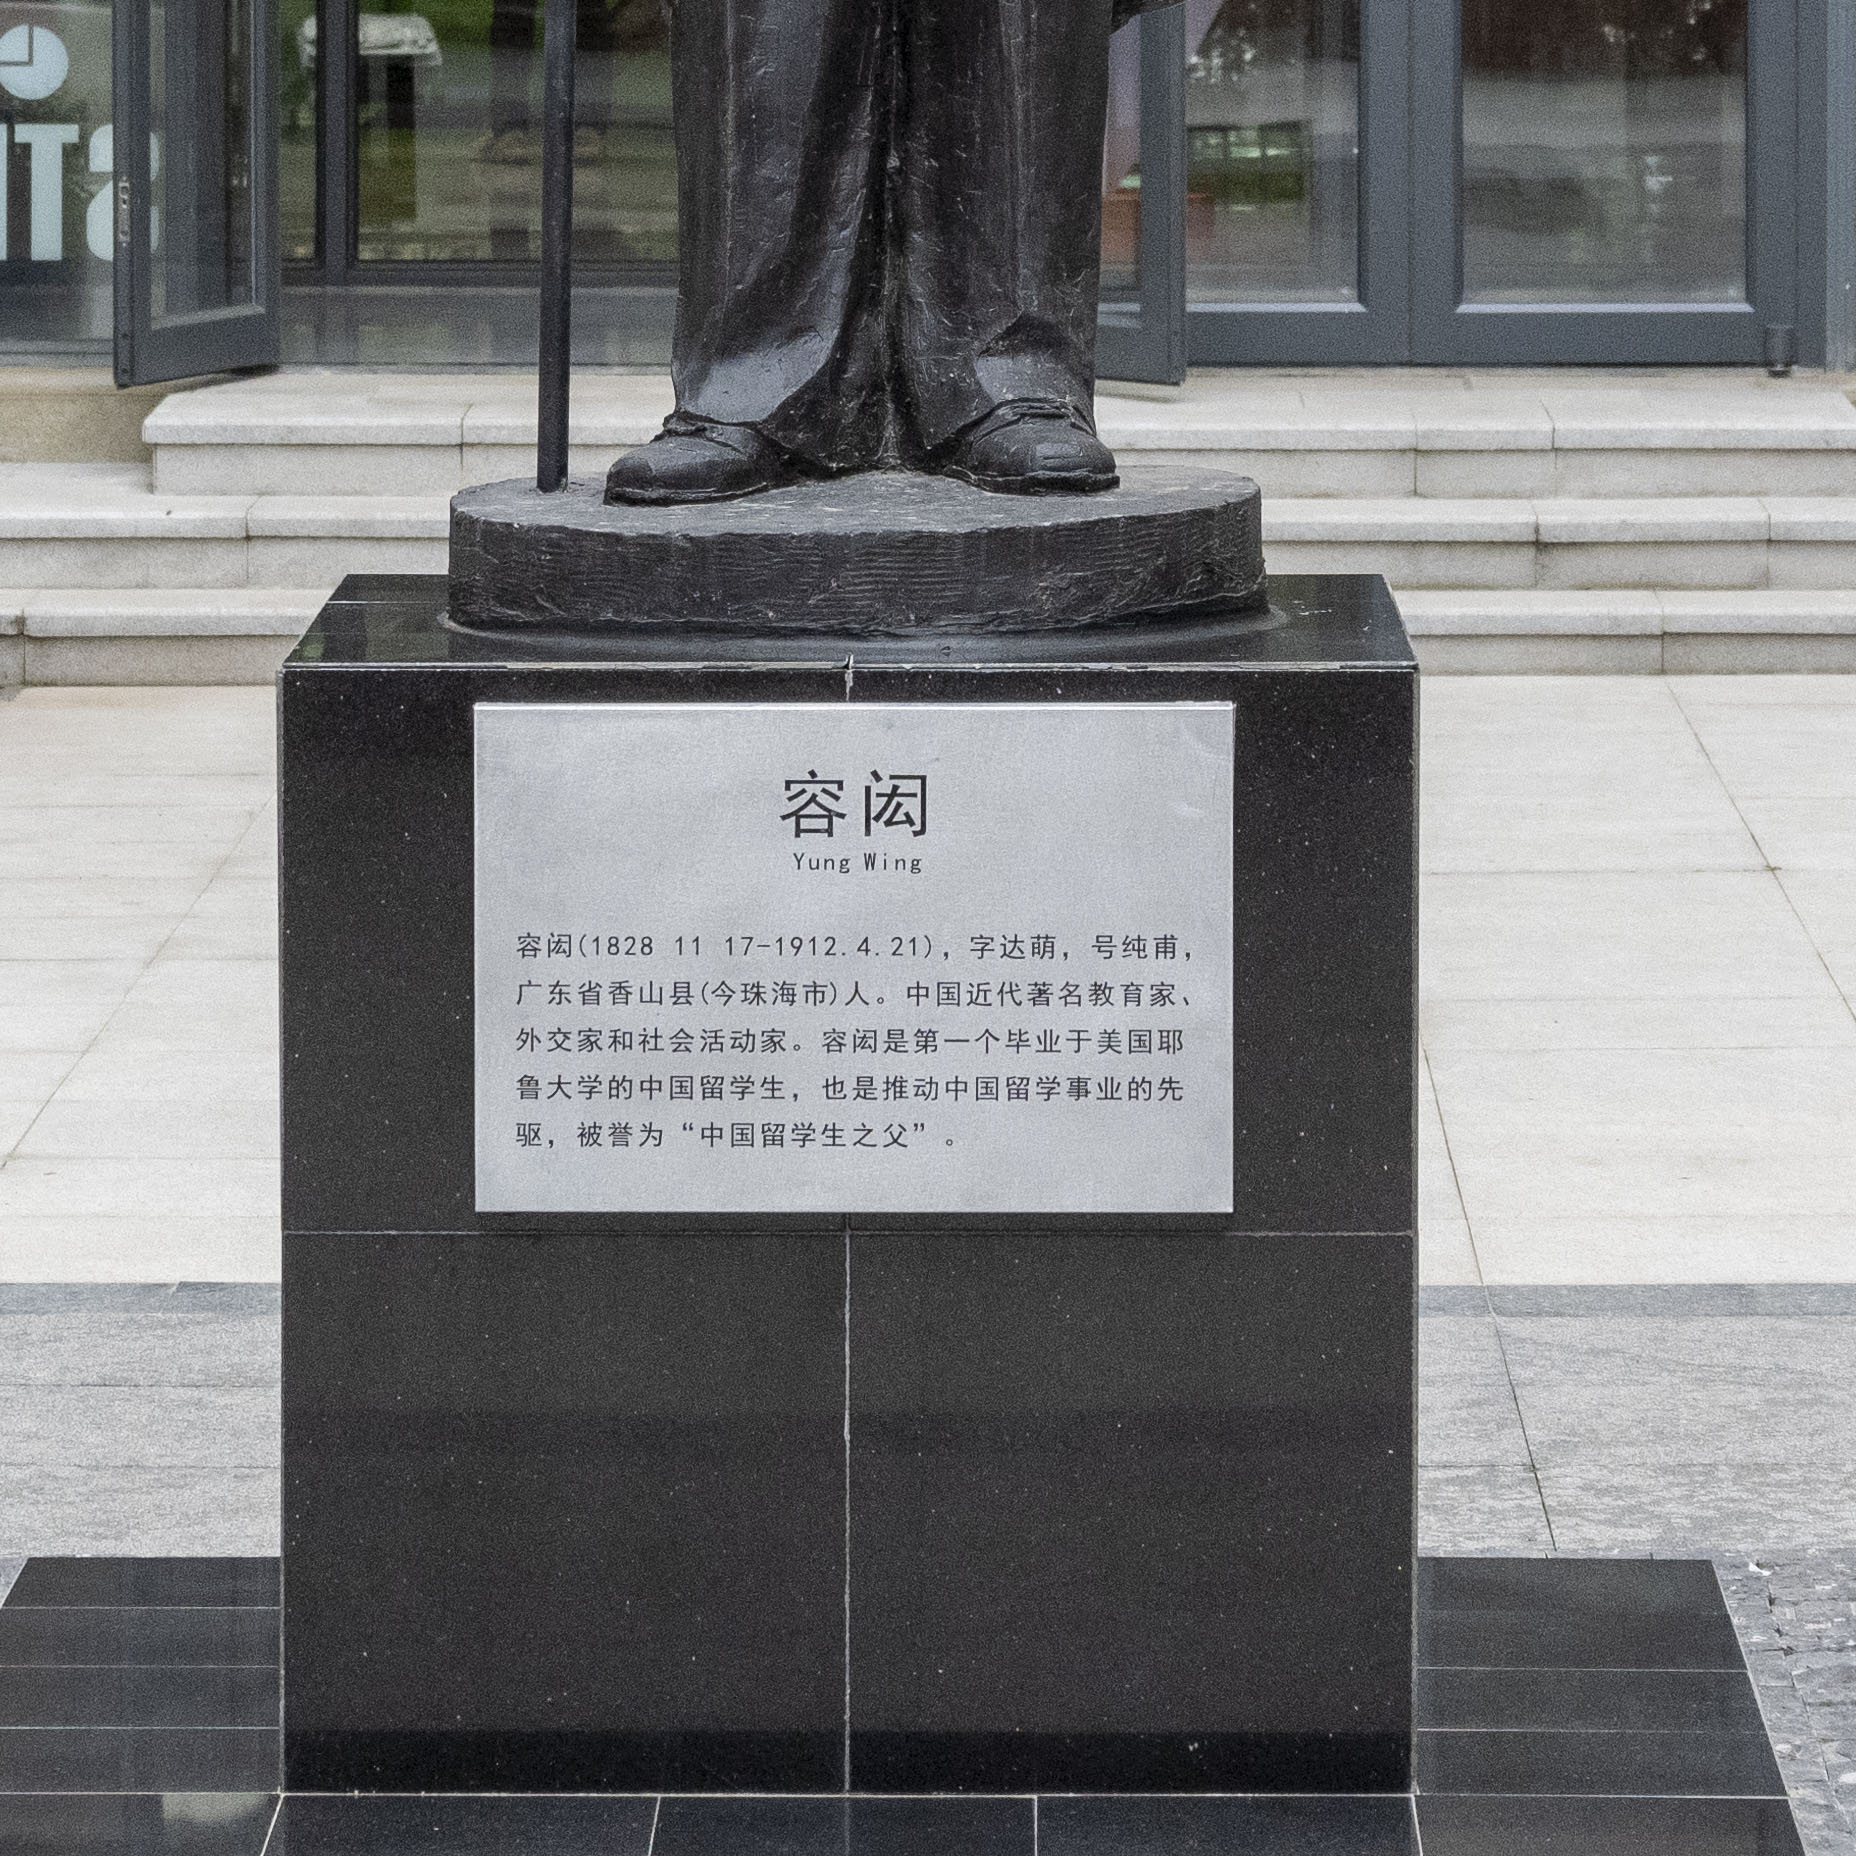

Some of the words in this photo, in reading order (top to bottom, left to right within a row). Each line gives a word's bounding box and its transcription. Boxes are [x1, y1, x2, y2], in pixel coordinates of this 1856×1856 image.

[779, 769, 927, 838] 容闳
[793, 852, 851, 874] Yung
[863, 852, 922, 875] Wing
[516, 1027, 1184, 1055] 外交家和社会活动家。容闳是第一个毕业于美国耶
[516, 1074, 1184, 1102] 鲁大学的中国留学生，也是推动中国留学事业的先
